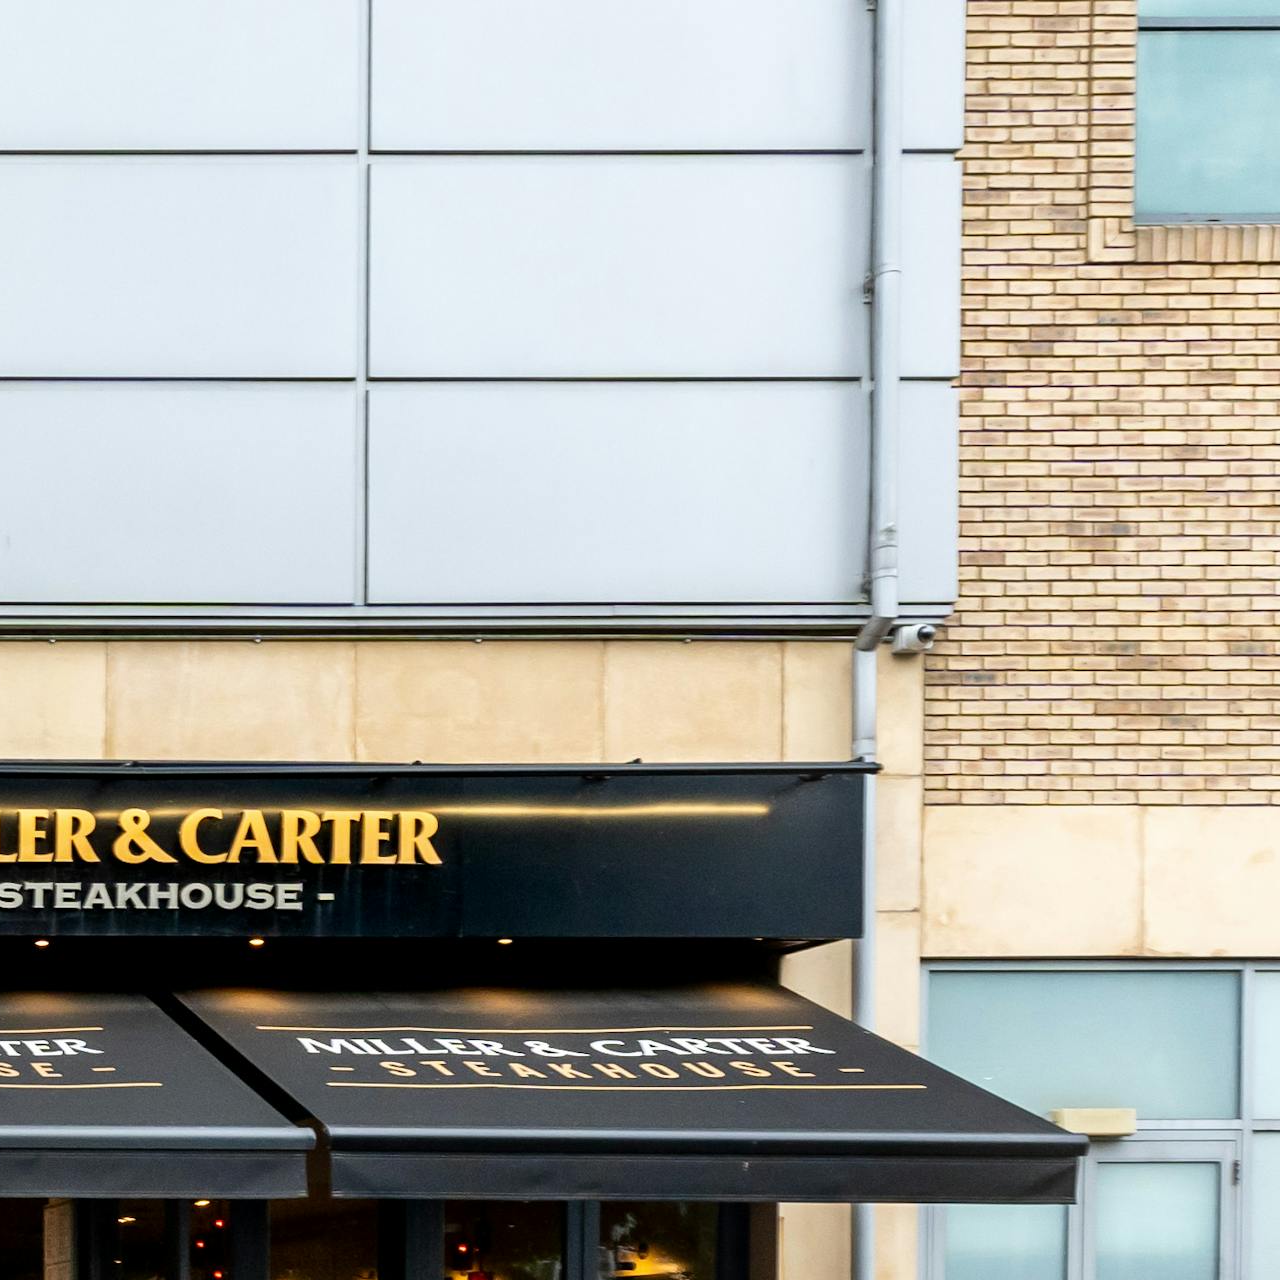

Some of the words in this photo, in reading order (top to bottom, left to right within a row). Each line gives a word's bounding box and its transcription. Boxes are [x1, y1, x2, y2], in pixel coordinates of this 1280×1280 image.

[112, 808, 179, 864] &
[179, 808, 443, 865] CARTER
[296, 1037, 525, 1057] MILLER
[523, 1040, 590, 1057] &
[589, 1037, 837, 1057] CARTER
[378, 1060, 816, 1079] STEAKHOUSE
